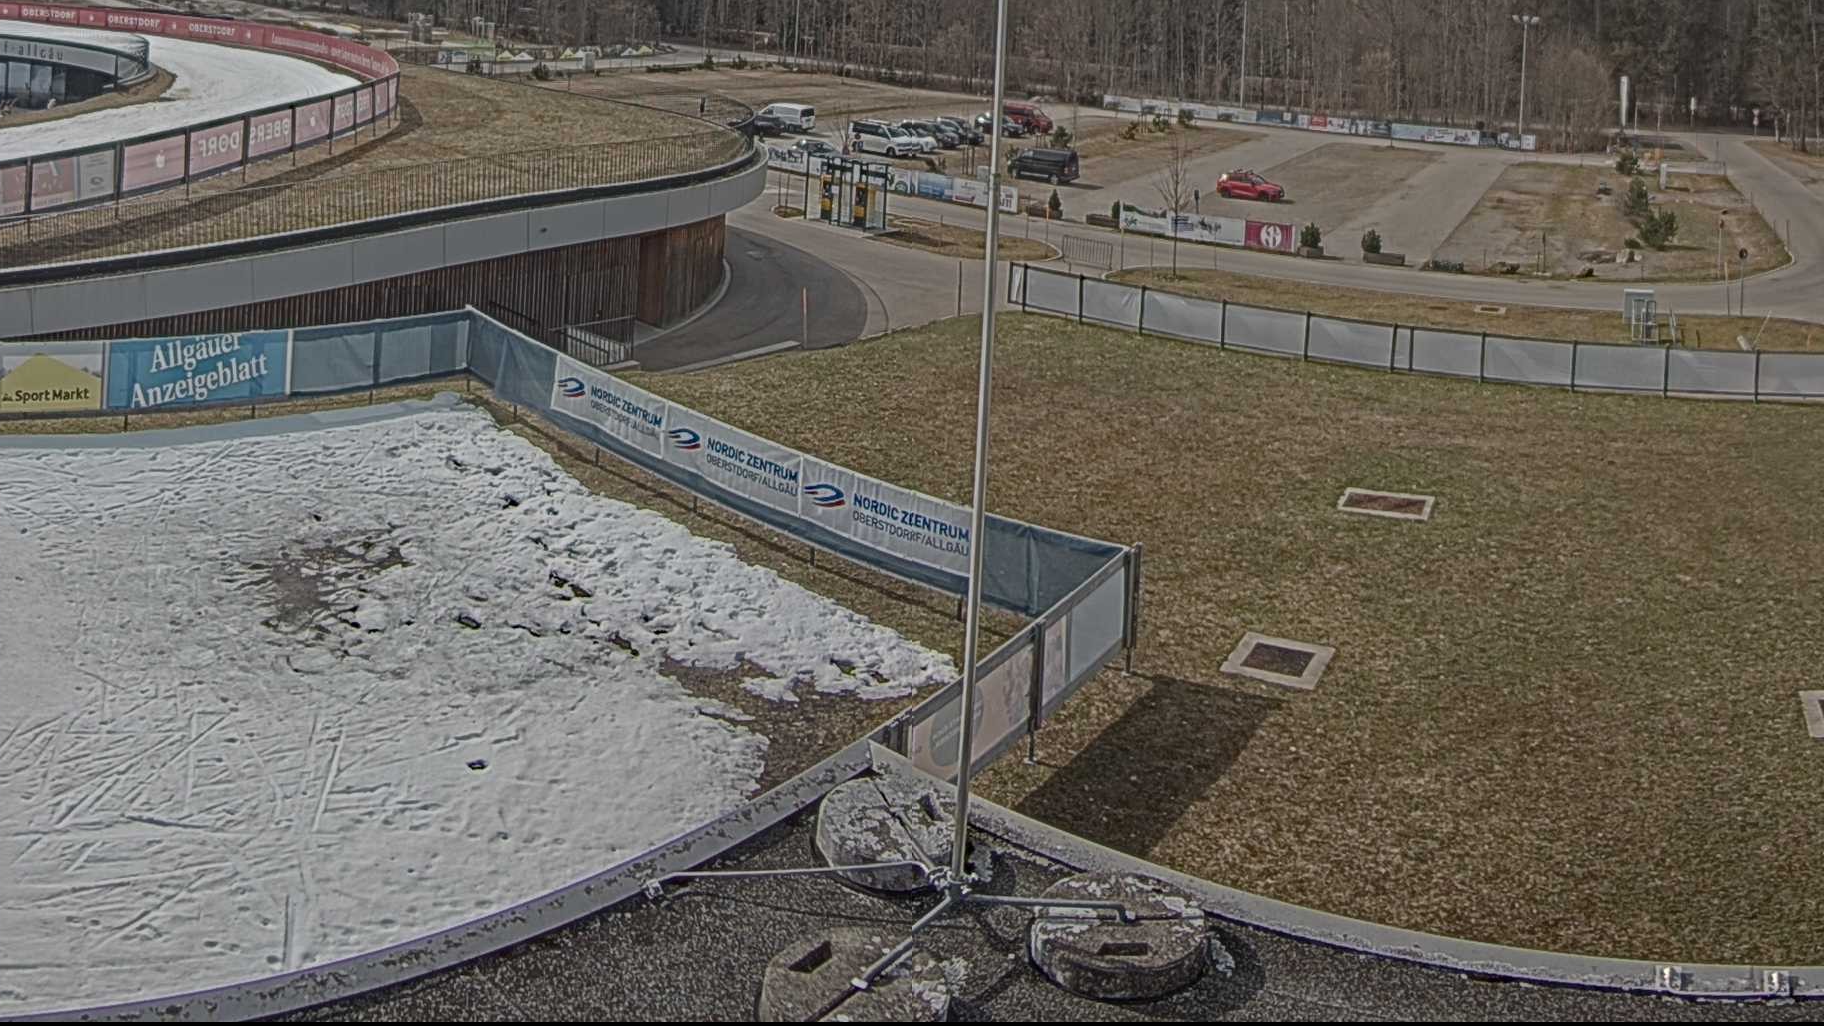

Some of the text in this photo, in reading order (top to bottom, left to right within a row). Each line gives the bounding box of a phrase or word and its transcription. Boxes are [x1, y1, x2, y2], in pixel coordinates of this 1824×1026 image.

[149, 333, 243, 372] Allgäuer
[130, 353, 269, 409] Anzeigeblatt
[590, 385, 663, 428] NORDIC ZENTRUM
[707, 437, 800, 484] NORDIC ZENTRUM
[853, 493, 970, 543] NORDIC ZENTRUM
